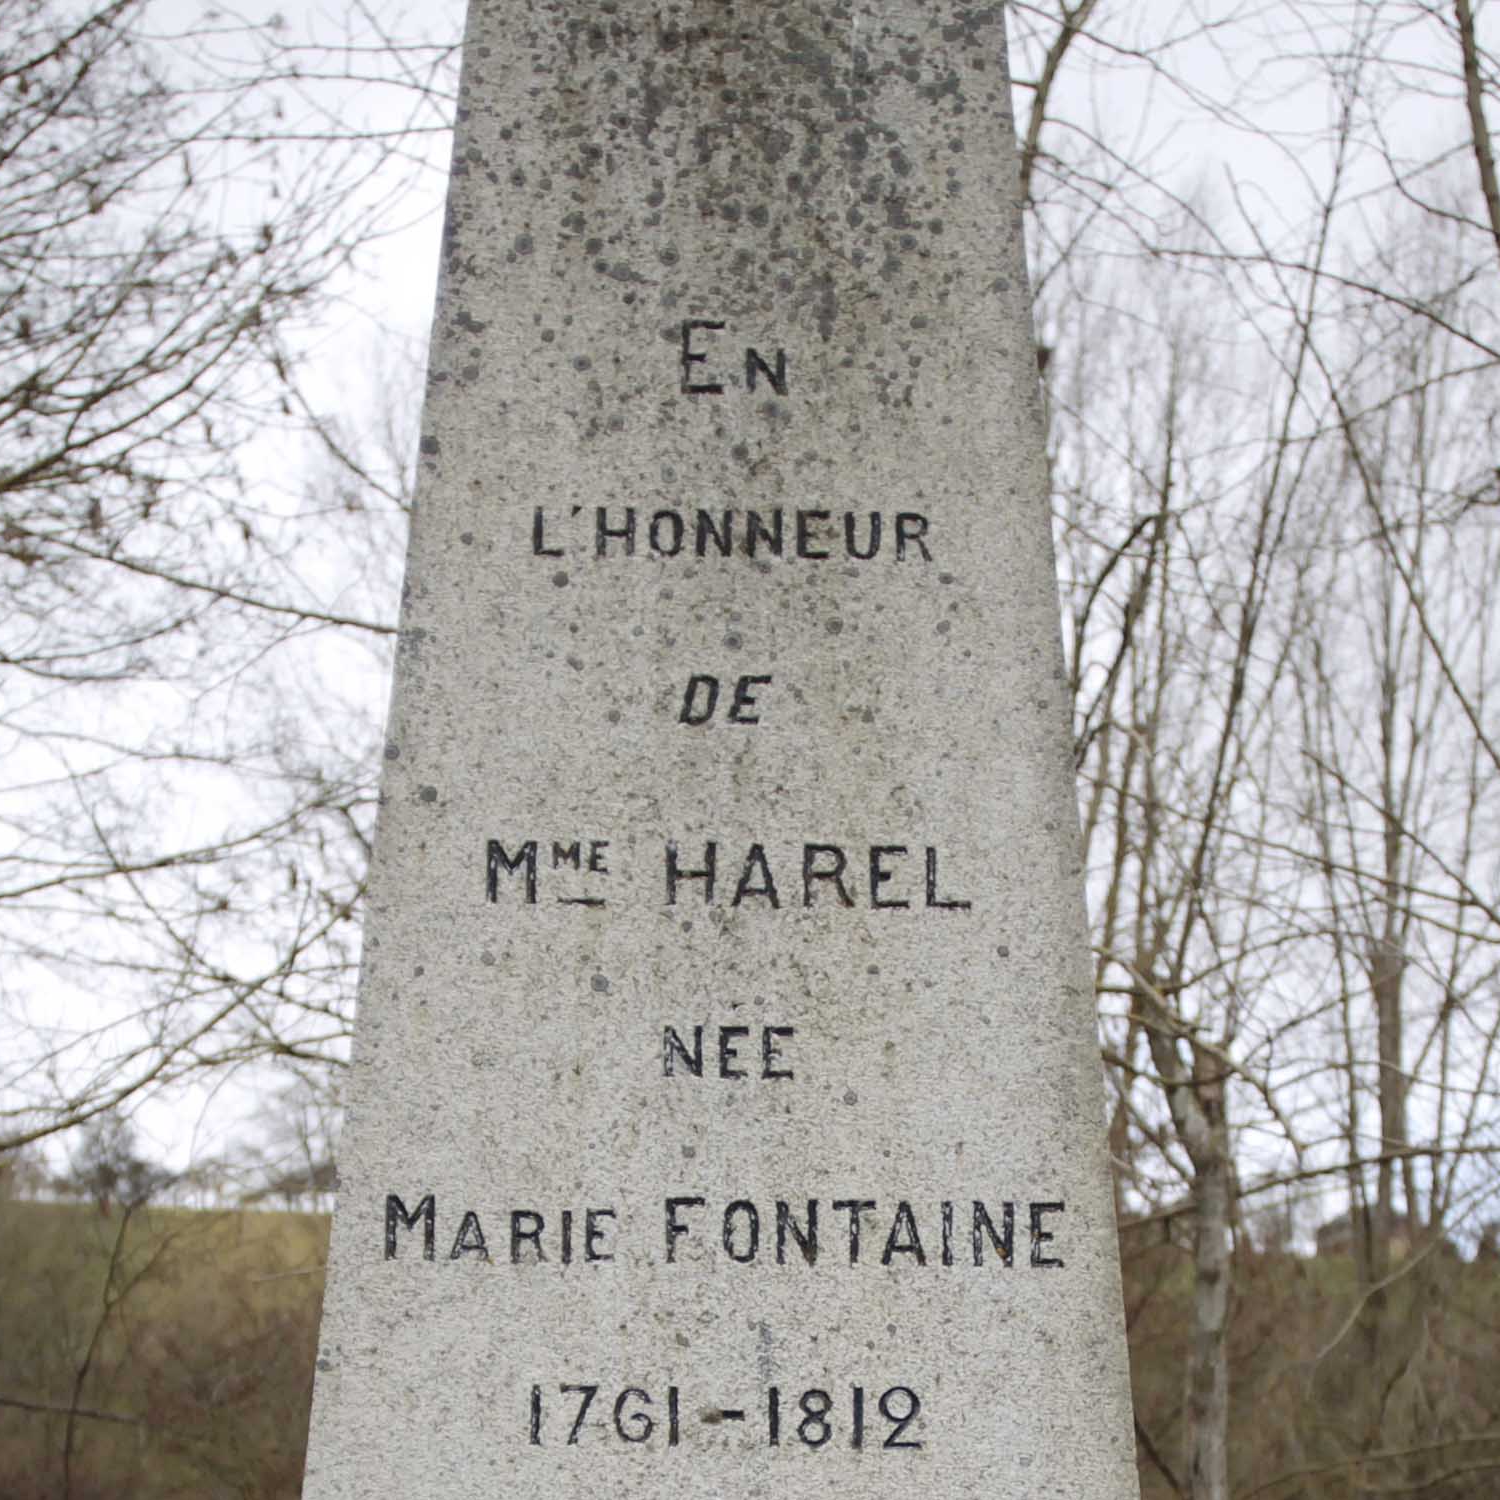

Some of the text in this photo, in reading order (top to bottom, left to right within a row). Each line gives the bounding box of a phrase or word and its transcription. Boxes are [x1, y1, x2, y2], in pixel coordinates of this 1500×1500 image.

[531, 505, 934, 562] L'HONNEUR
[678, 675, 773, 726] DE
[664, 839, 973, 910] HAREL
[661, 1025, 796, 1080] NEE
[384, 1193, 1066, 1269] MARIE FONTAINE
[528, 1384, 924, 1450] 1761-1812
